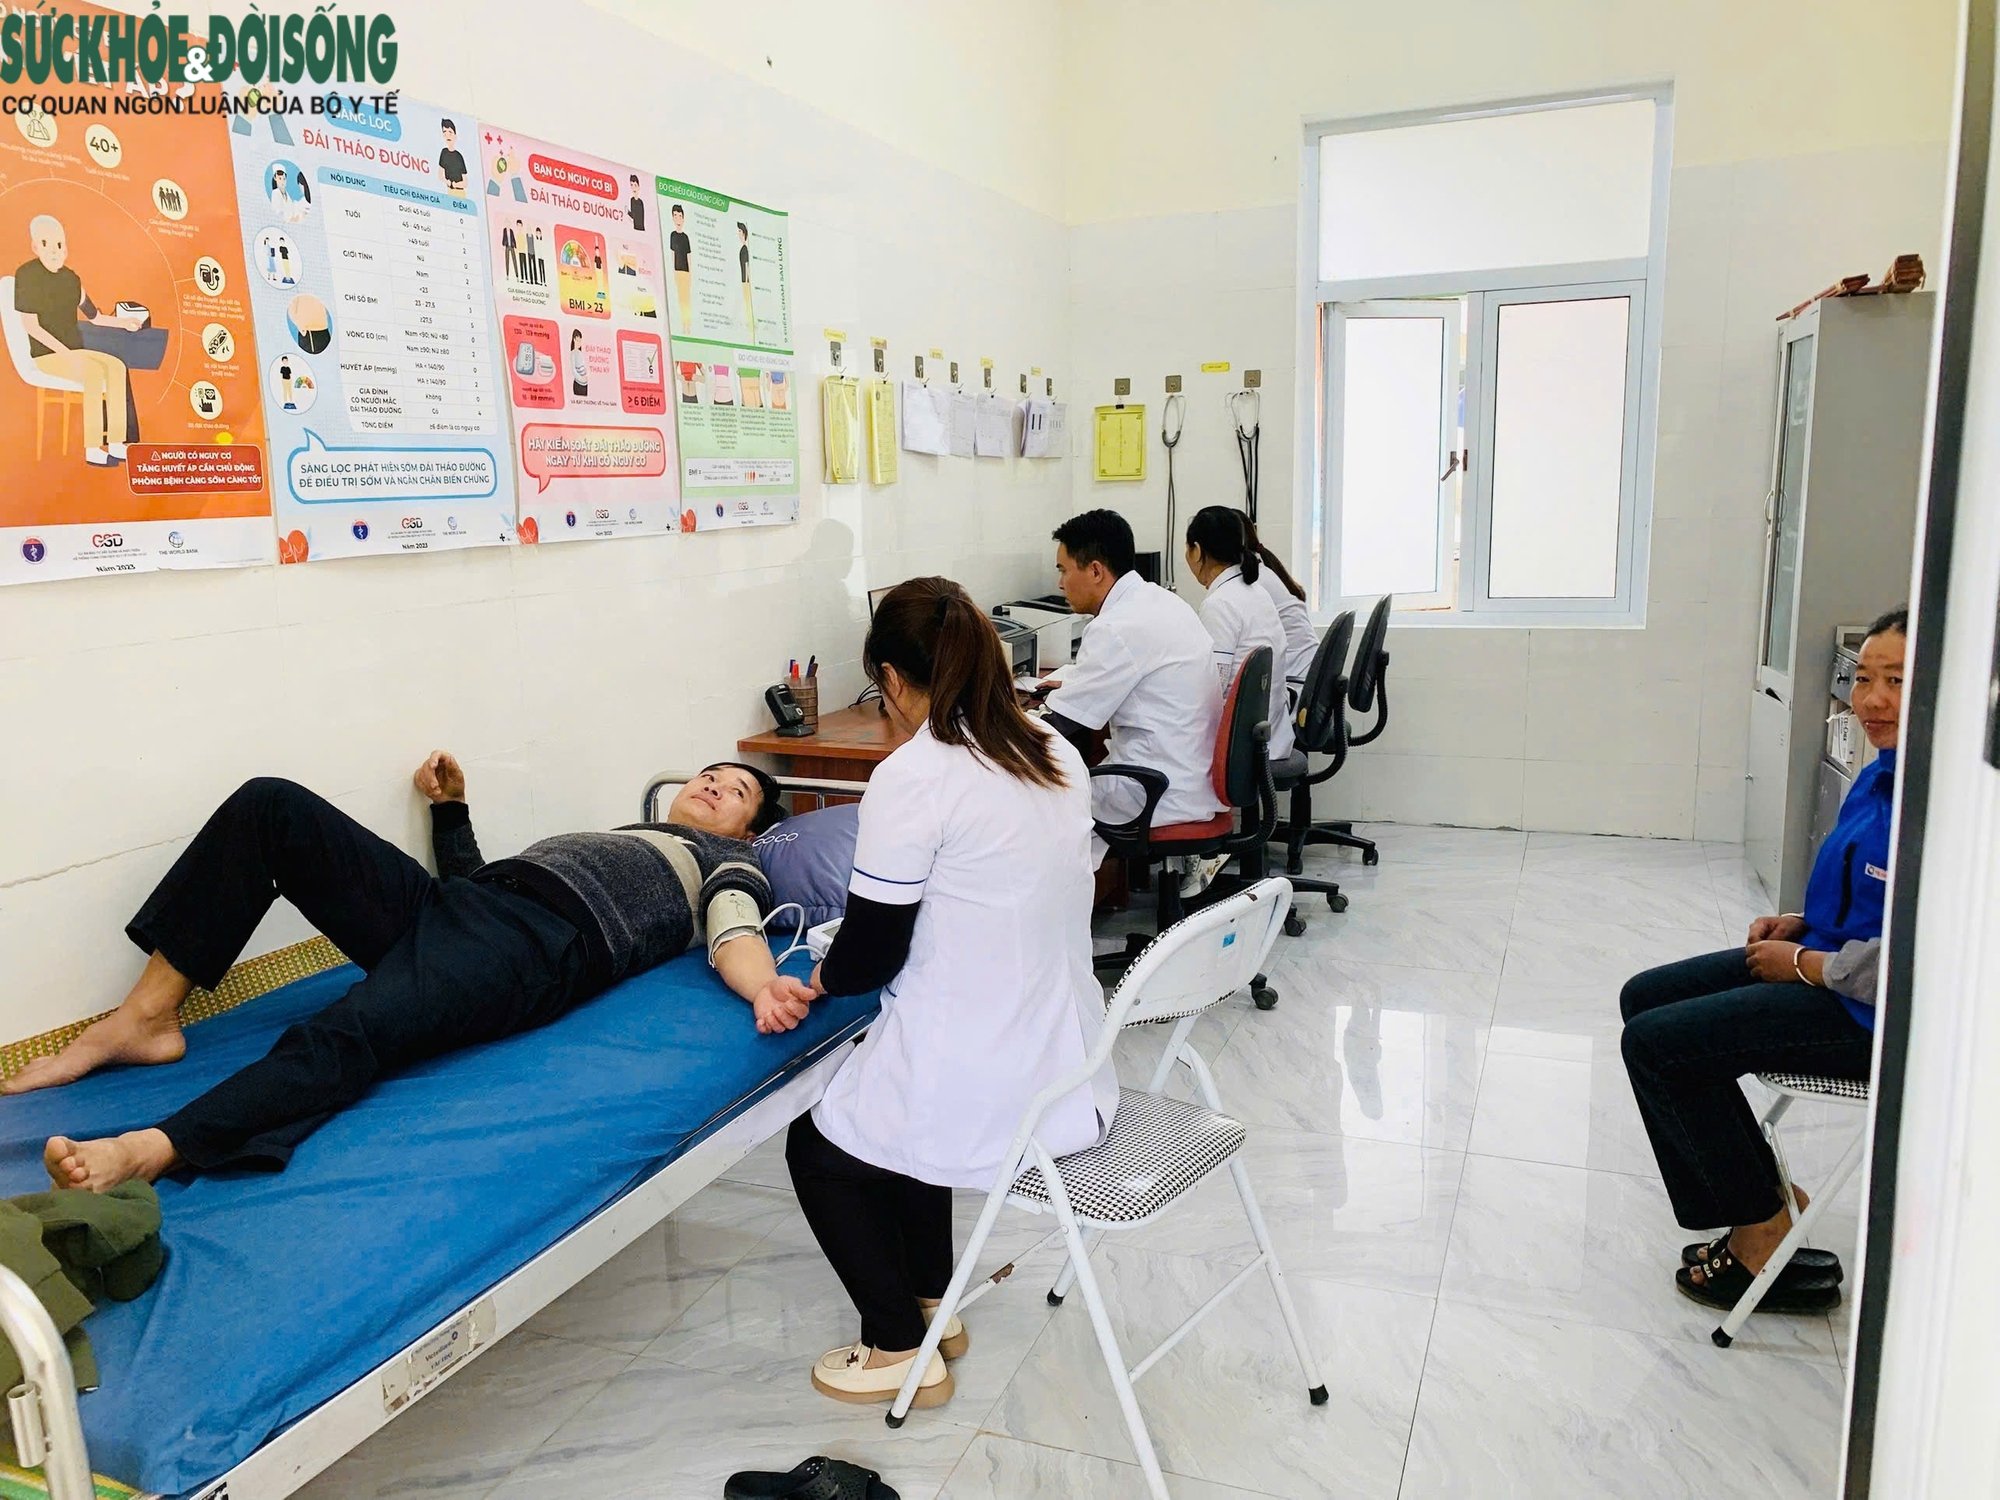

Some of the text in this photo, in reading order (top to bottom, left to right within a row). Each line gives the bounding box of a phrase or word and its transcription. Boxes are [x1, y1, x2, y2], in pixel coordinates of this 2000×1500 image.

[90, 135, 119, 154] 40+
[303, 128, 430, 174] ĐÁI THÁO ĐƯỜNG
[346, 177, 366, 187] DUNG
[533, 161, 552, 178] BẠN
[554, 167, 566, 180] CÓ
[567, 172, 590, 187] NGUY
[604, 183, 613, 195] BỊ
[530, 187, 624, 221] ĐÁI THÁO ĐƯỜNG?
[569, 298, 604, 314] BMI 23
[640, 395, 661, 408] ĐIỂM
[547, 436, 569, 452] KIỂM
[187, 450, 199, 460] CÓ
[199, 451, 219, 461] NGUY
[583, 455, 597, 468] KHI
[137, 463, 160, 473] TĂNG
[162, 463, 186, 473] HUYẾT
[187, 463, 197, 473] ÁP
[216, 462, 232, 473] CHỦ
[234, 463, 255, 474] ĐỘNG
[300, 461, 486, 476] SÀNG LỌC PHÁT HIỆN SỚM ĐÁI THÁO ĐƯỜNG
[132, 473, 261, 488] PHÒNG BỆNH CÀNG SỚM CÀNG TỐT
[299, 473, 490, 489] ĐỂ ĐIỀU TRỊ SỚM VÀ NGĂN CHẶN BIẾN CHỨNG
[416, 542, 428, 550] 2023
[97, 562, 136, 573] Năm 2023
